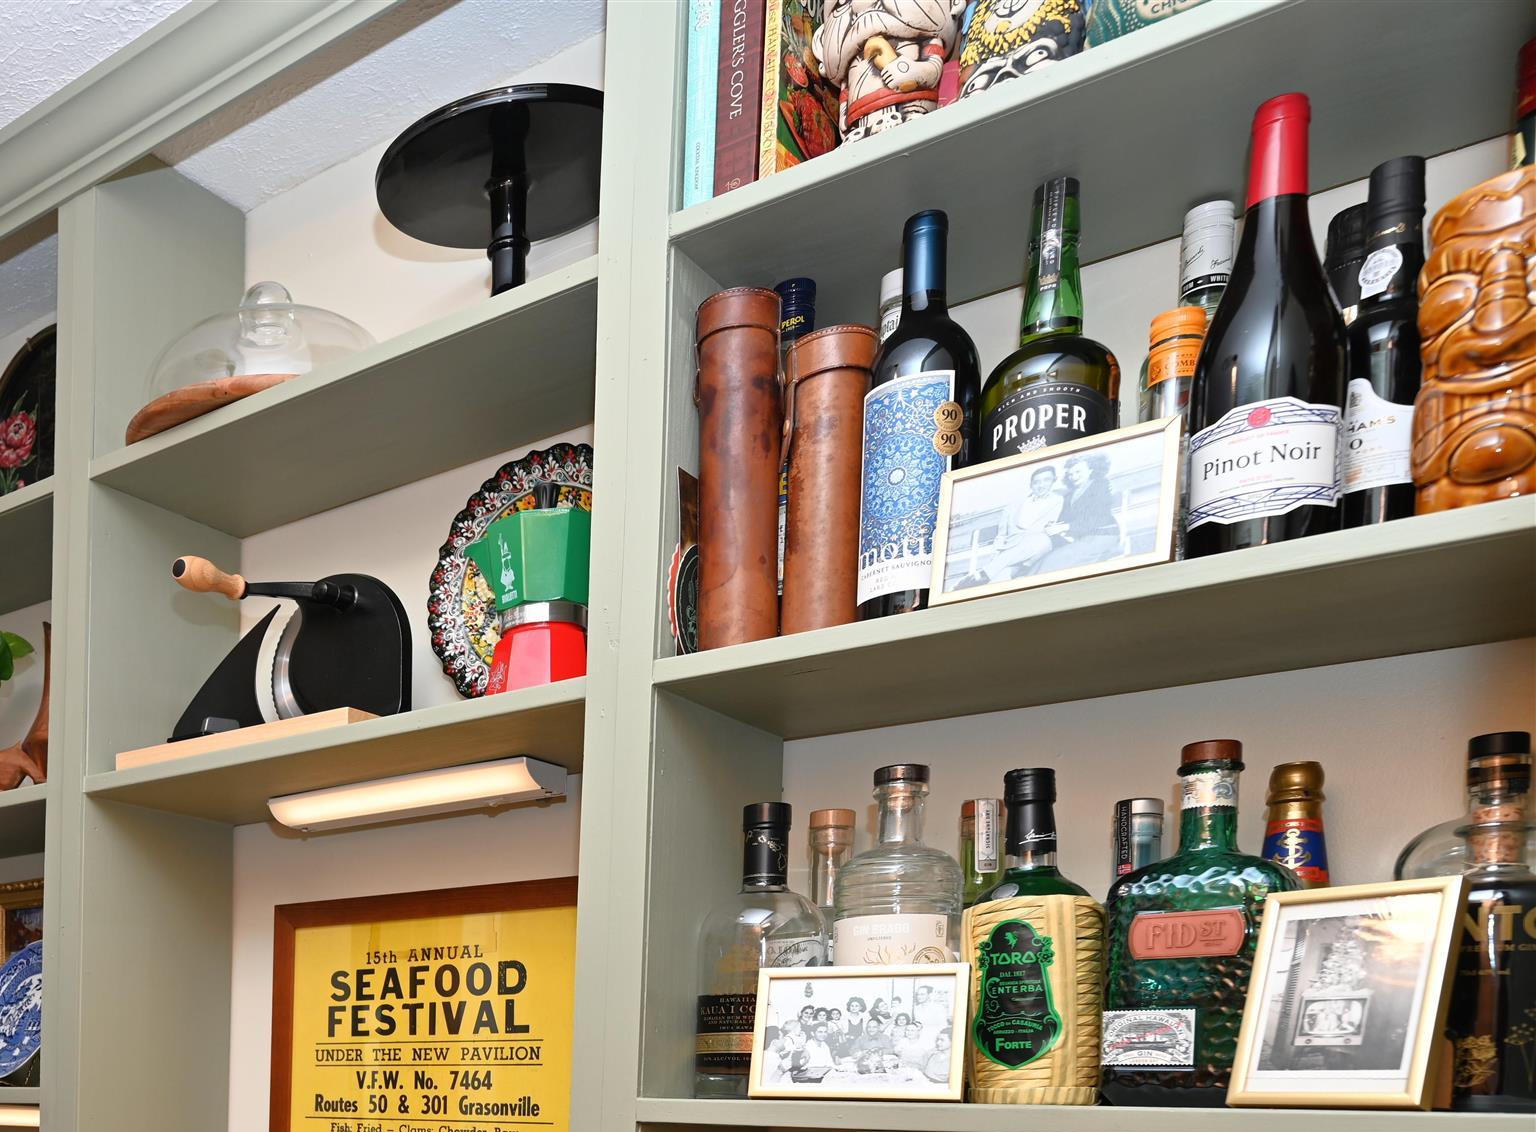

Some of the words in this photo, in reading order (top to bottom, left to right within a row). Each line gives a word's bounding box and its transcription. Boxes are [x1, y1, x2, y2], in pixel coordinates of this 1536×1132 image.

[730, 70, 744, 120] COVE
[780, 315, 806, 329] PEROL
[1042, 386, 1081, 394] SMOOTH
[941, 408, 957, 421] 90
[992, 403, 1087, 451] PROPER
[940, 433, 957, 446] 90
[1203, 450, 1264, 481] Pinot
[1270, 441, 1322, 463] Noir
[860, 532, 936, 570] moti
[891, 559, 932, 571] SAUVIGNO
[1120, 806, 1128, 860] HANDCRAFTED
[1199, 920, 1226, 937] ST
[366, 951, 397, 964] 15th
[408, 944, 483, 962] ANNUAL
[990, 951, 1037, 965] TORO
[330, 960, 527, 1001] SEAFOOD
[986, 977, 1044, 999] CENTERBA
[327, 999, 530, 1037] FESTIVAL
[1110, 1016, 1142, 1036] ORIGINAL
[315, 1049, 363, 1062] UNDER
[373, 1048, 401, 1062] THE
[412, 1048, 450, 1061] NEW
[460, 1047, 541, 1061] PAVILION
[995, 1038, 1032, 1051] FORTE
[357, 1071, 404, 1089] V.F.W.
[414, 1071, 438, 1089] No.
[450, 1070, 492, 1090] 7464
[315, 1094, 358, 1113] Routes
[368, 1095, 387, 1114] 50
[398, 1095, 409, 1114] &
[421, 1095, 448, 1115] 301
[459, 1096, 540, 1117] Grasonville
